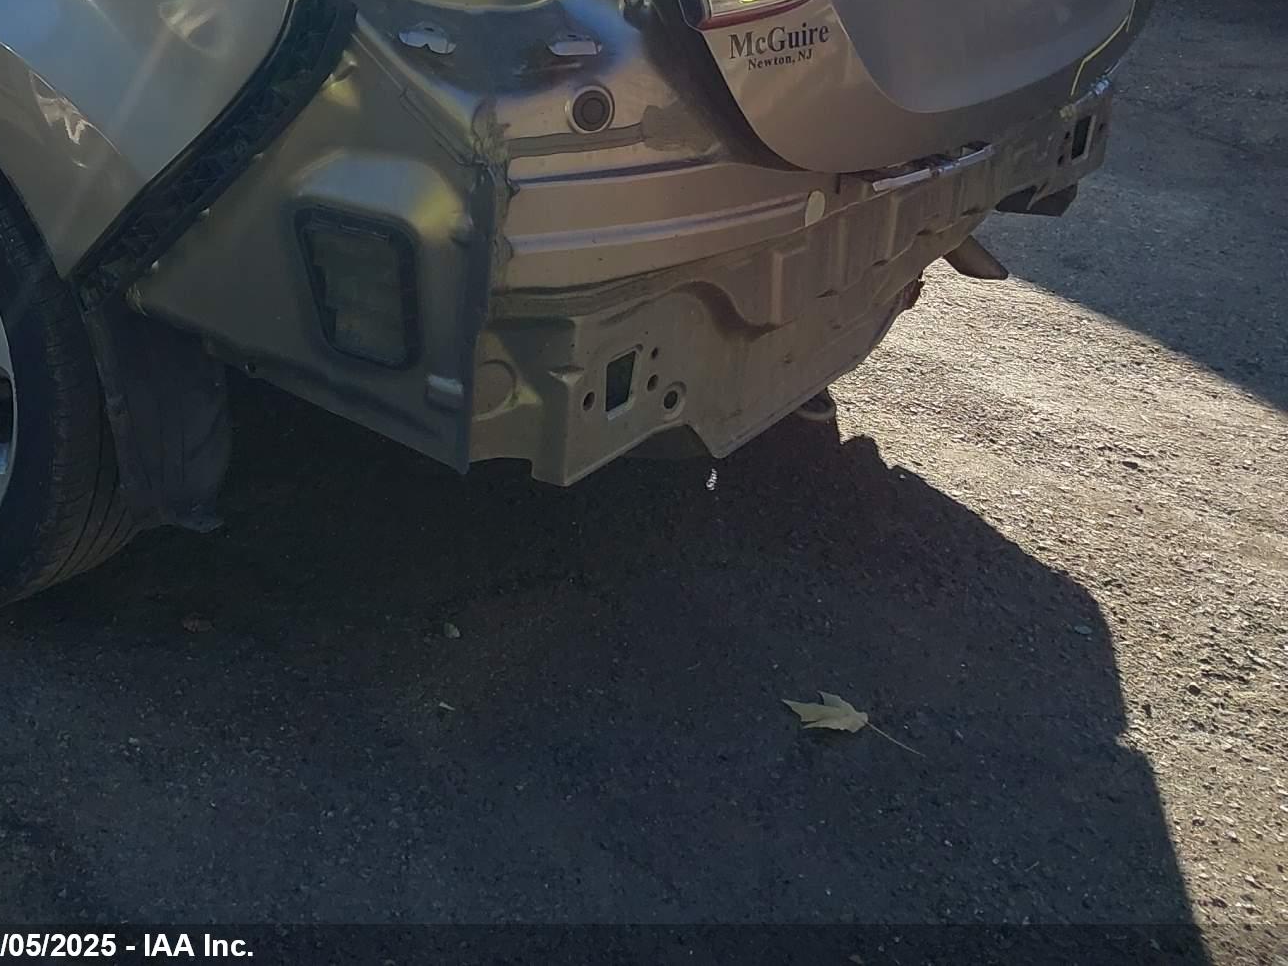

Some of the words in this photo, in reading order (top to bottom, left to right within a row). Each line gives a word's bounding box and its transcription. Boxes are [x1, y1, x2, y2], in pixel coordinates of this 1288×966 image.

[728, 22, 830, 59] McGuire
[748, 55, 796, 71] Newton,
[798, 48, 813, 61] NJ
